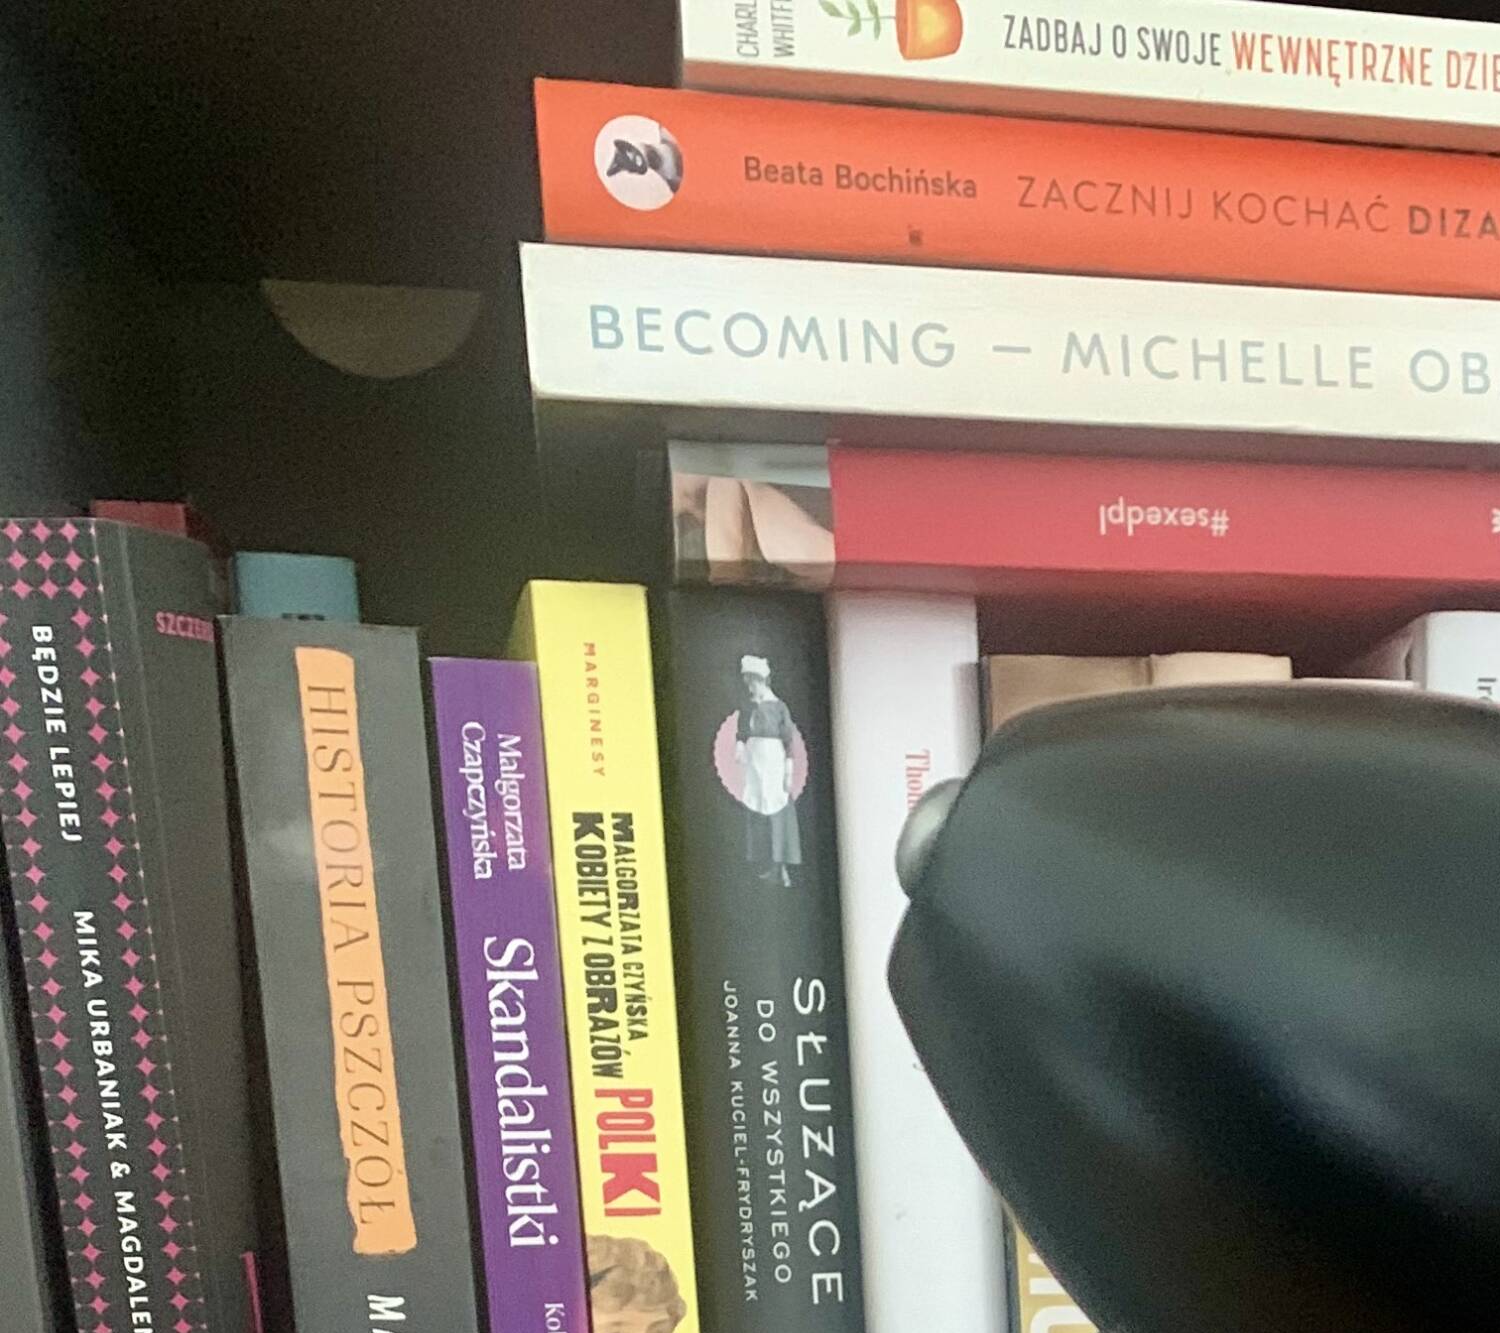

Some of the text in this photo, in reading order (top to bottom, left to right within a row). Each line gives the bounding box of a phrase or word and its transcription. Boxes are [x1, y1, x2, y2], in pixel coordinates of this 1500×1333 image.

[1003, 14, 1101, 56] ZADBAJ
[1112, 24, 1127, 59] O
[1137, 26, 1222, 67] SWOJE
[1231, 31, 1434, 88] WEWNĘTRZNE
[744, 156, 824, 188] Beata
[835, 163, 978, 200] Bochińska
[1017, 175, 1193, 220] ZACZNIJ
[1213, 190, 1389, 233] KOCHAĆ
[588, 304, 956, 368] BECOMING
[1060, 331, 1374, 390] MICHELLE
[1098, 495, 1230, 537] #sexedpl
[31, 625, 68, 734] BĘDZIE
[582, 641, 606, 778] MARGINESY
[49, 746, 83, 843] LEPIEJ
[458, 721, 498, 880] Czapczyńska
[496, 732, 528, 871] Małgorzata
[571, 811, 612, 929] KOBIETY
[610, 811, 653, 1042] MAŁGORZATA CZYŃSKA
[72, 910, 104, 989] MIKA
[306, 684, 404, 1225] HISTORIA PSZCZÓŁ
[85, 999, 129, 1151] URBANIAK
[582, 952, 632, 1079] OBRAZÓW
[484, 936, 560, 1248] Skandalistki
[593, 1087, 662, 1218] POLKI
[722, 980, 759, 1302] JOANNA KUCIEL-FRYDRYSZAK
[756, 999, 792, 1284] DO WSZYSTKIEGO
[792, 976, 844, 1305] SŁUŻĄCE
[110, 1161, 132, 1180] &
